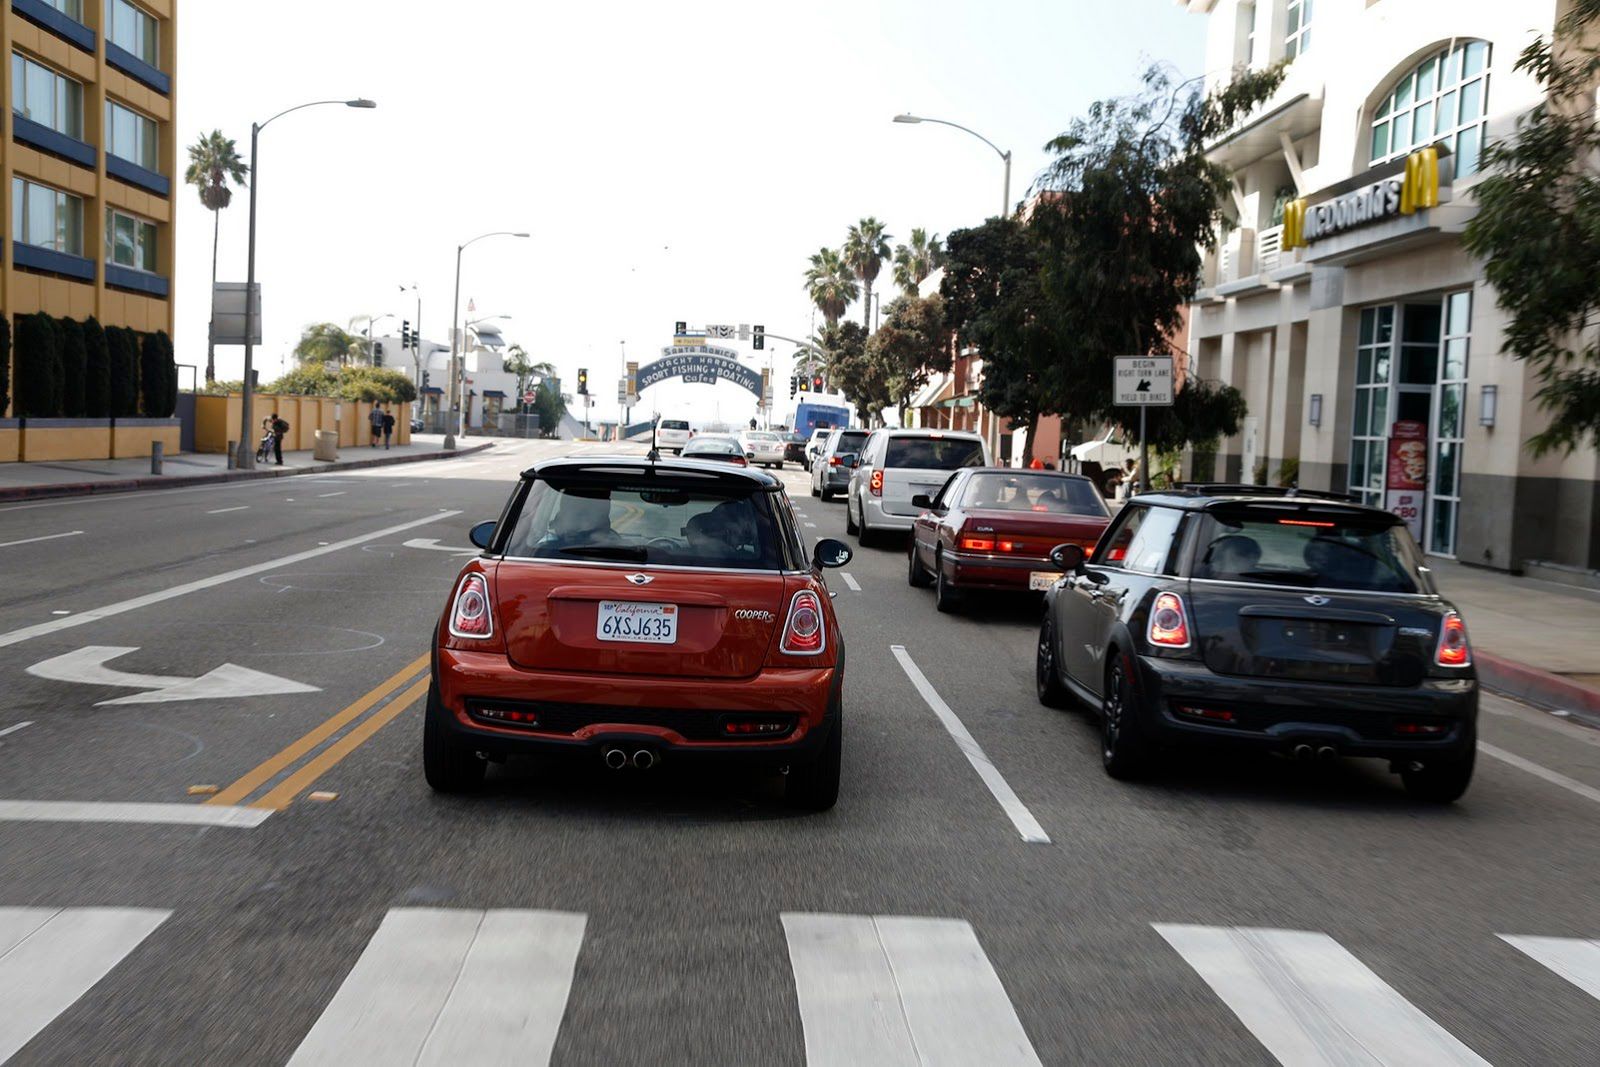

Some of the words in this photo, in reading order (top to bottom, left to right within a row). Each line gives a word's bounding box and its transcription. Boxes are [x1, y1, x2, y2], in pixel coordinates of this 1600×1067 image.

[1302, 180, 1400, 240] McDonald's
[658, 357, 693, 368] YACHT
[700, 357, 742, 373] HARBOR
[1132, 360, 1156, 368] BEGIN
[642, 368, 669, 387] SPORT
[672, 364, 709, 375] FISHING
[717, 367, 755, 391] BOATING
[1118, 369, 1135, 377] RIGHT
[1137, 369, 1152, 377] TURN
[1154, 369, 1170, 377] LANE
[1121, 393, 1138, 401] YIELD
[1139, 393, 1147, 401] TO
[1149, 393, 1167, 401] BIKES
[615, 604, 660, 617] California
[734, 609, 769, 620] COOPER
[603, 615, 671, 637] 6XSJ635
